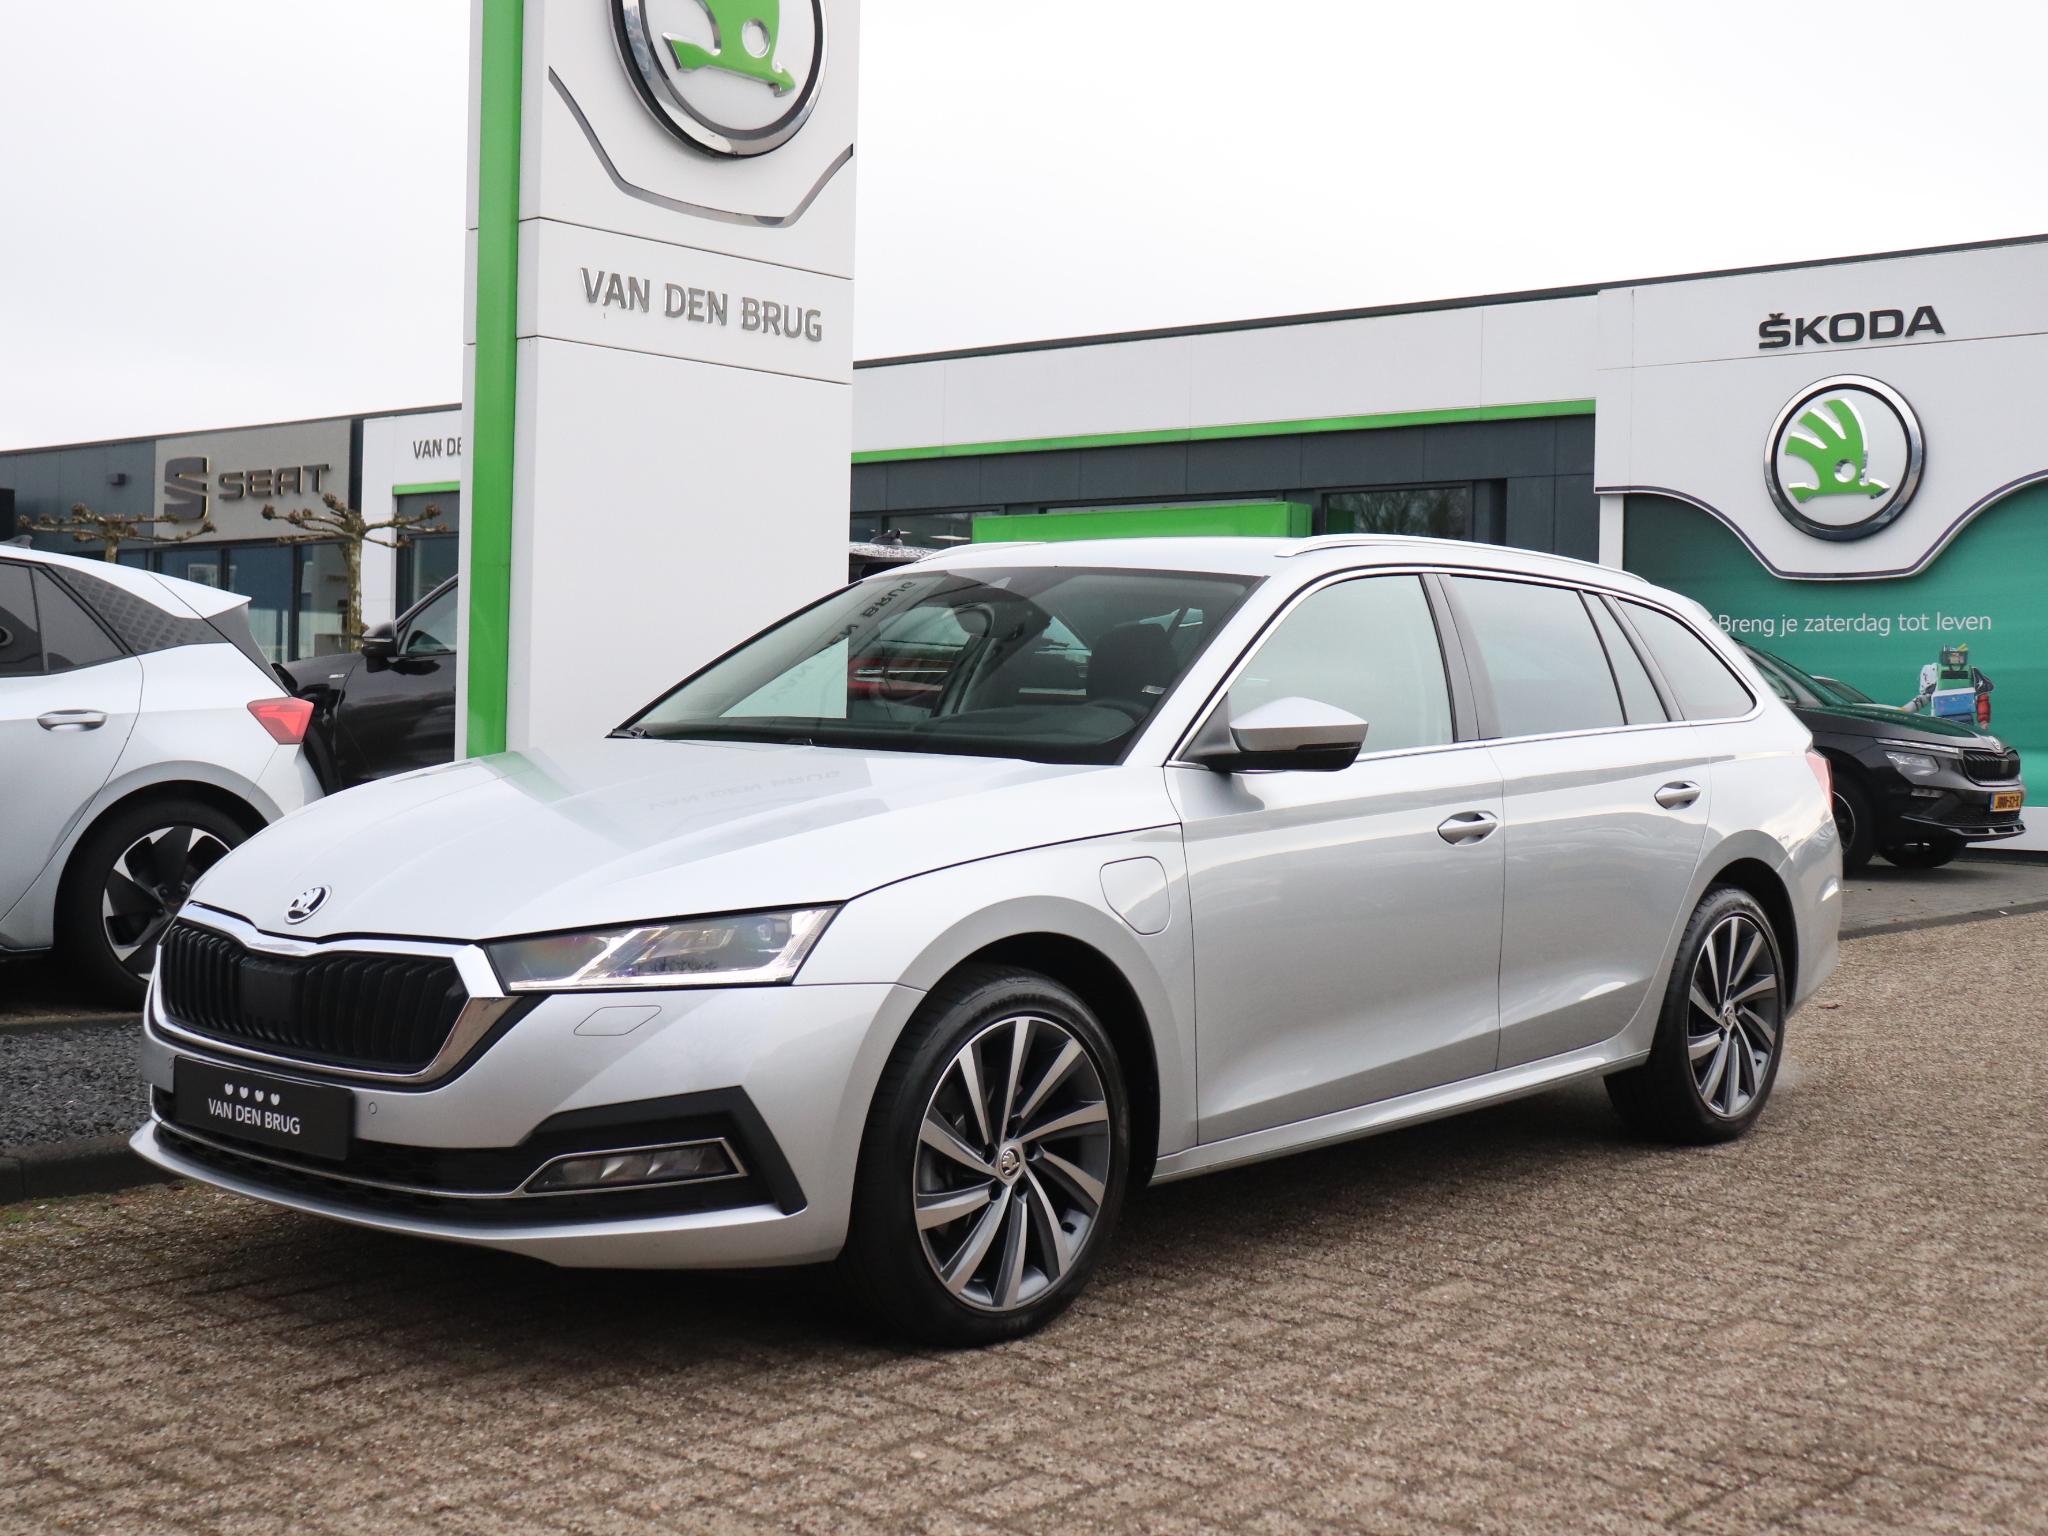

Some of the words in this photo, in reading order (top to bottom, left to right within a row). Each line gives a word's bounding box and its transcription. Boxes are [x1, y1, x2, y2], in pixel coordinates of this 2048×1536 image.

[580, 267, 650, 313] VAN
[664, 282, 728, 326] DEN
[741, 296, 822, 342] BRUG
[1758, 305, 1946, 349] ŠKODA
[413, 439, 442, 459] VAN
[218, 463, 331, 500] SEAT
[1718, 614, 1775, 637] Breng
[1780, 614, 1798, 637] je
[1804, 613, 1891, 637] zaterdag
[1898, 614, 1929, 631] tot
[1936, 612, 1991, 631] leven
[208, 1098, 232, 1119] VAN
[235, 1104, 261, 1126] DEN
[264, 1111, 301, 1135] BRUG
